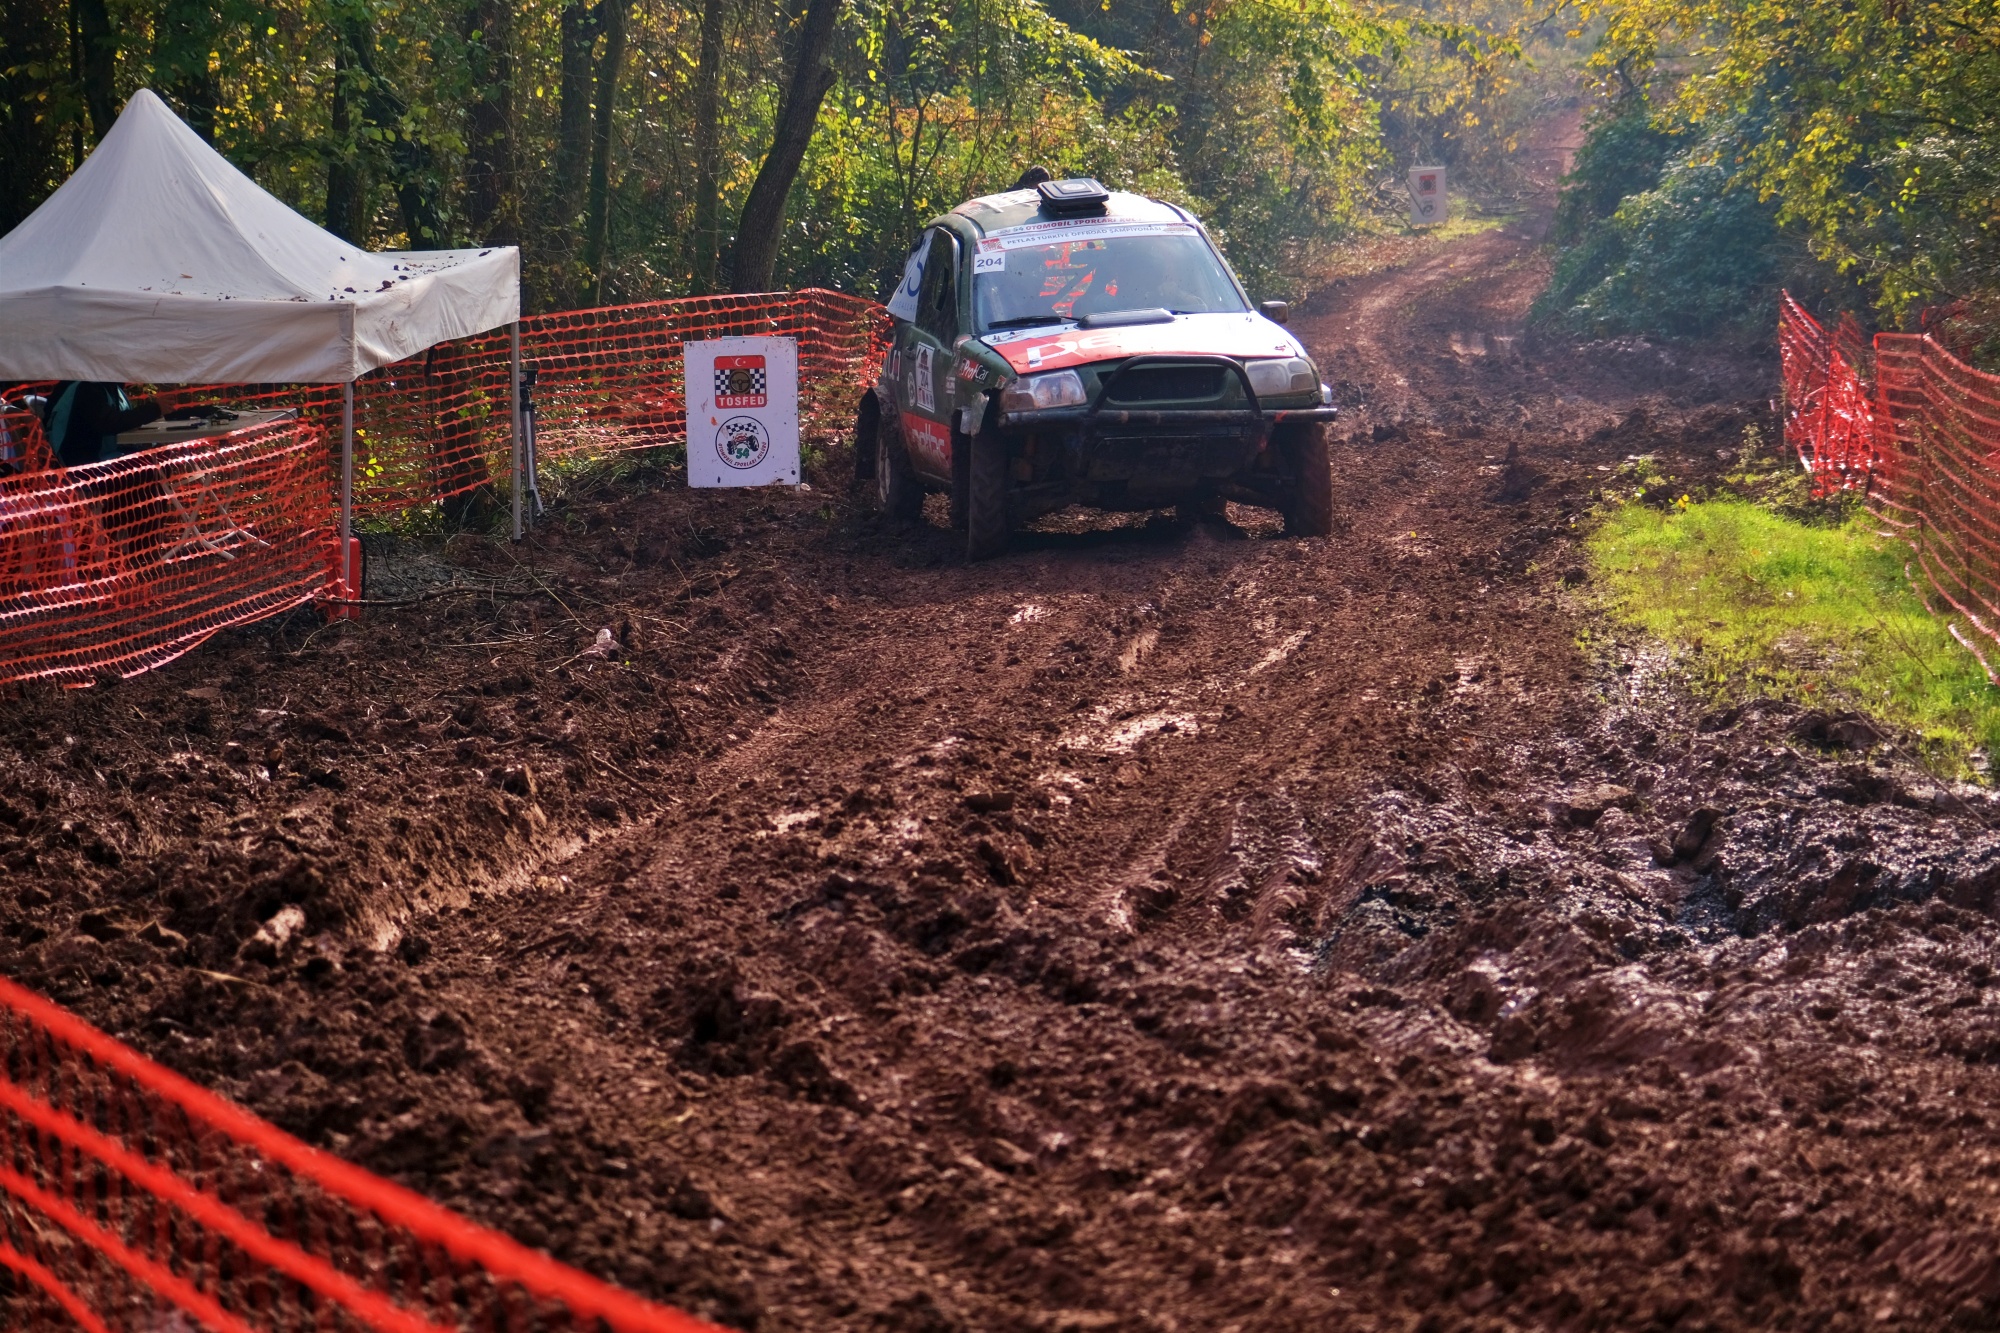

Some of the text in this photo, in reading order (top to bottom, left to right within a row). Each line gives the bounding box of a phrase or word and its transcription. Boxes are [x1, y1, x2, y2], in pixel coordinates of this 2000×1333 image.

[1026, 221, 1071, 231] OTOMOBİL
[1074, 217, 1116, 226] SPORLARI
[1007, 237, 1036, 245] PETLAS
[1037, 232, 1070, 241] TÜRKİYE
[976, 257, 1003, 268] 204
[718, 396, 765, 407] TOSFED
[718, 442, 733, 464] OTOMOBİL
[734, 458, 757, 467] SPORLARI
[735, 447, 750, 459] 54
